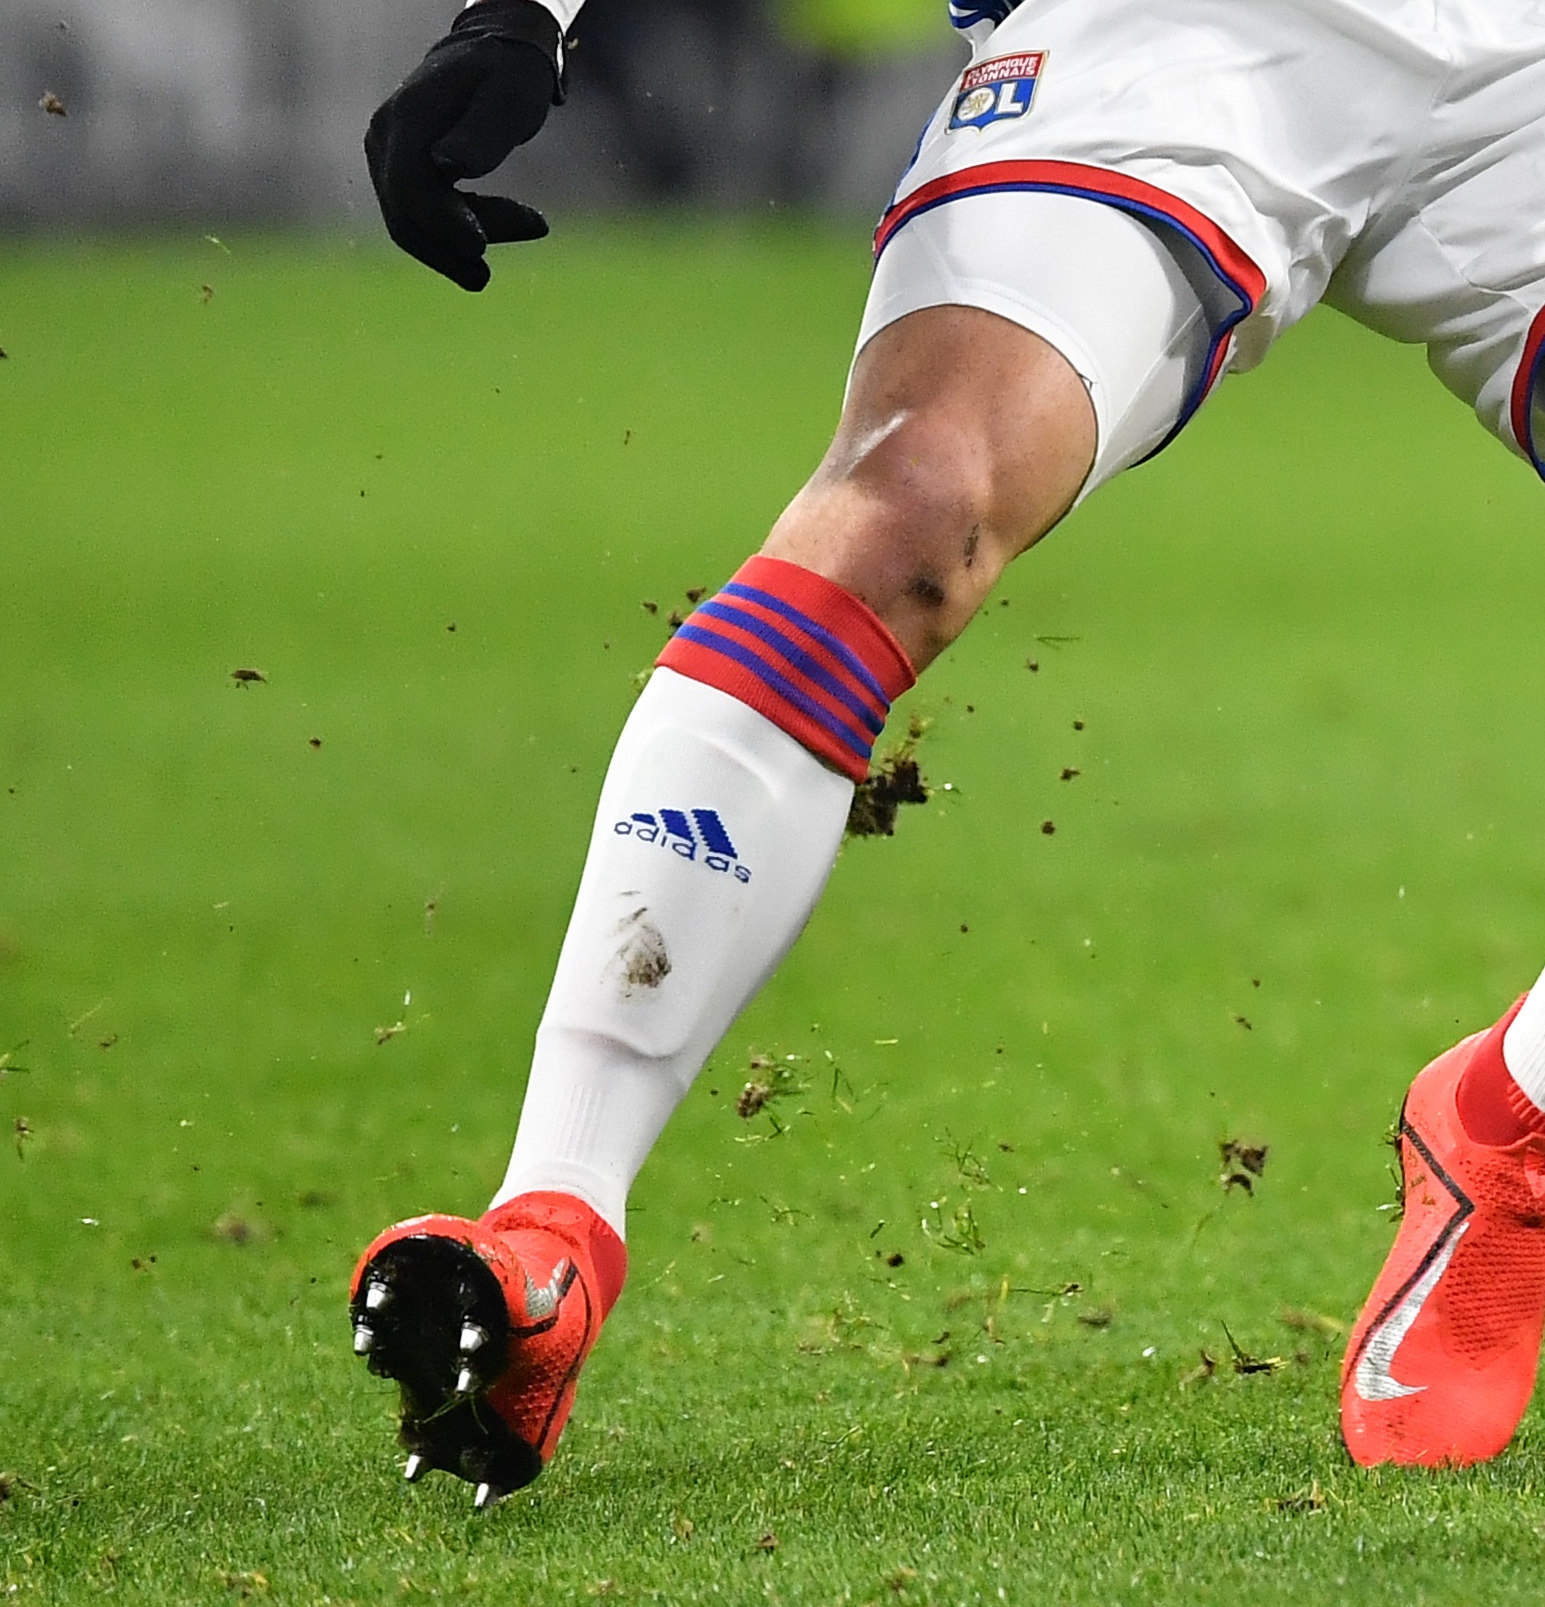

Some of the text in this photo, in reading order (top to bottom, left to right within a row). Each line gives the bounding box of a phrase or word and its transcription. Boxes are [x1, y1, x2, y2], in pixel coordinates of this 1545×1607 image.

[964, 66, 1035, 89] LYONNAIS
[968, 56, 1039, 79] OLYMPIQUE
[614, 821, 752, 884] adidas
